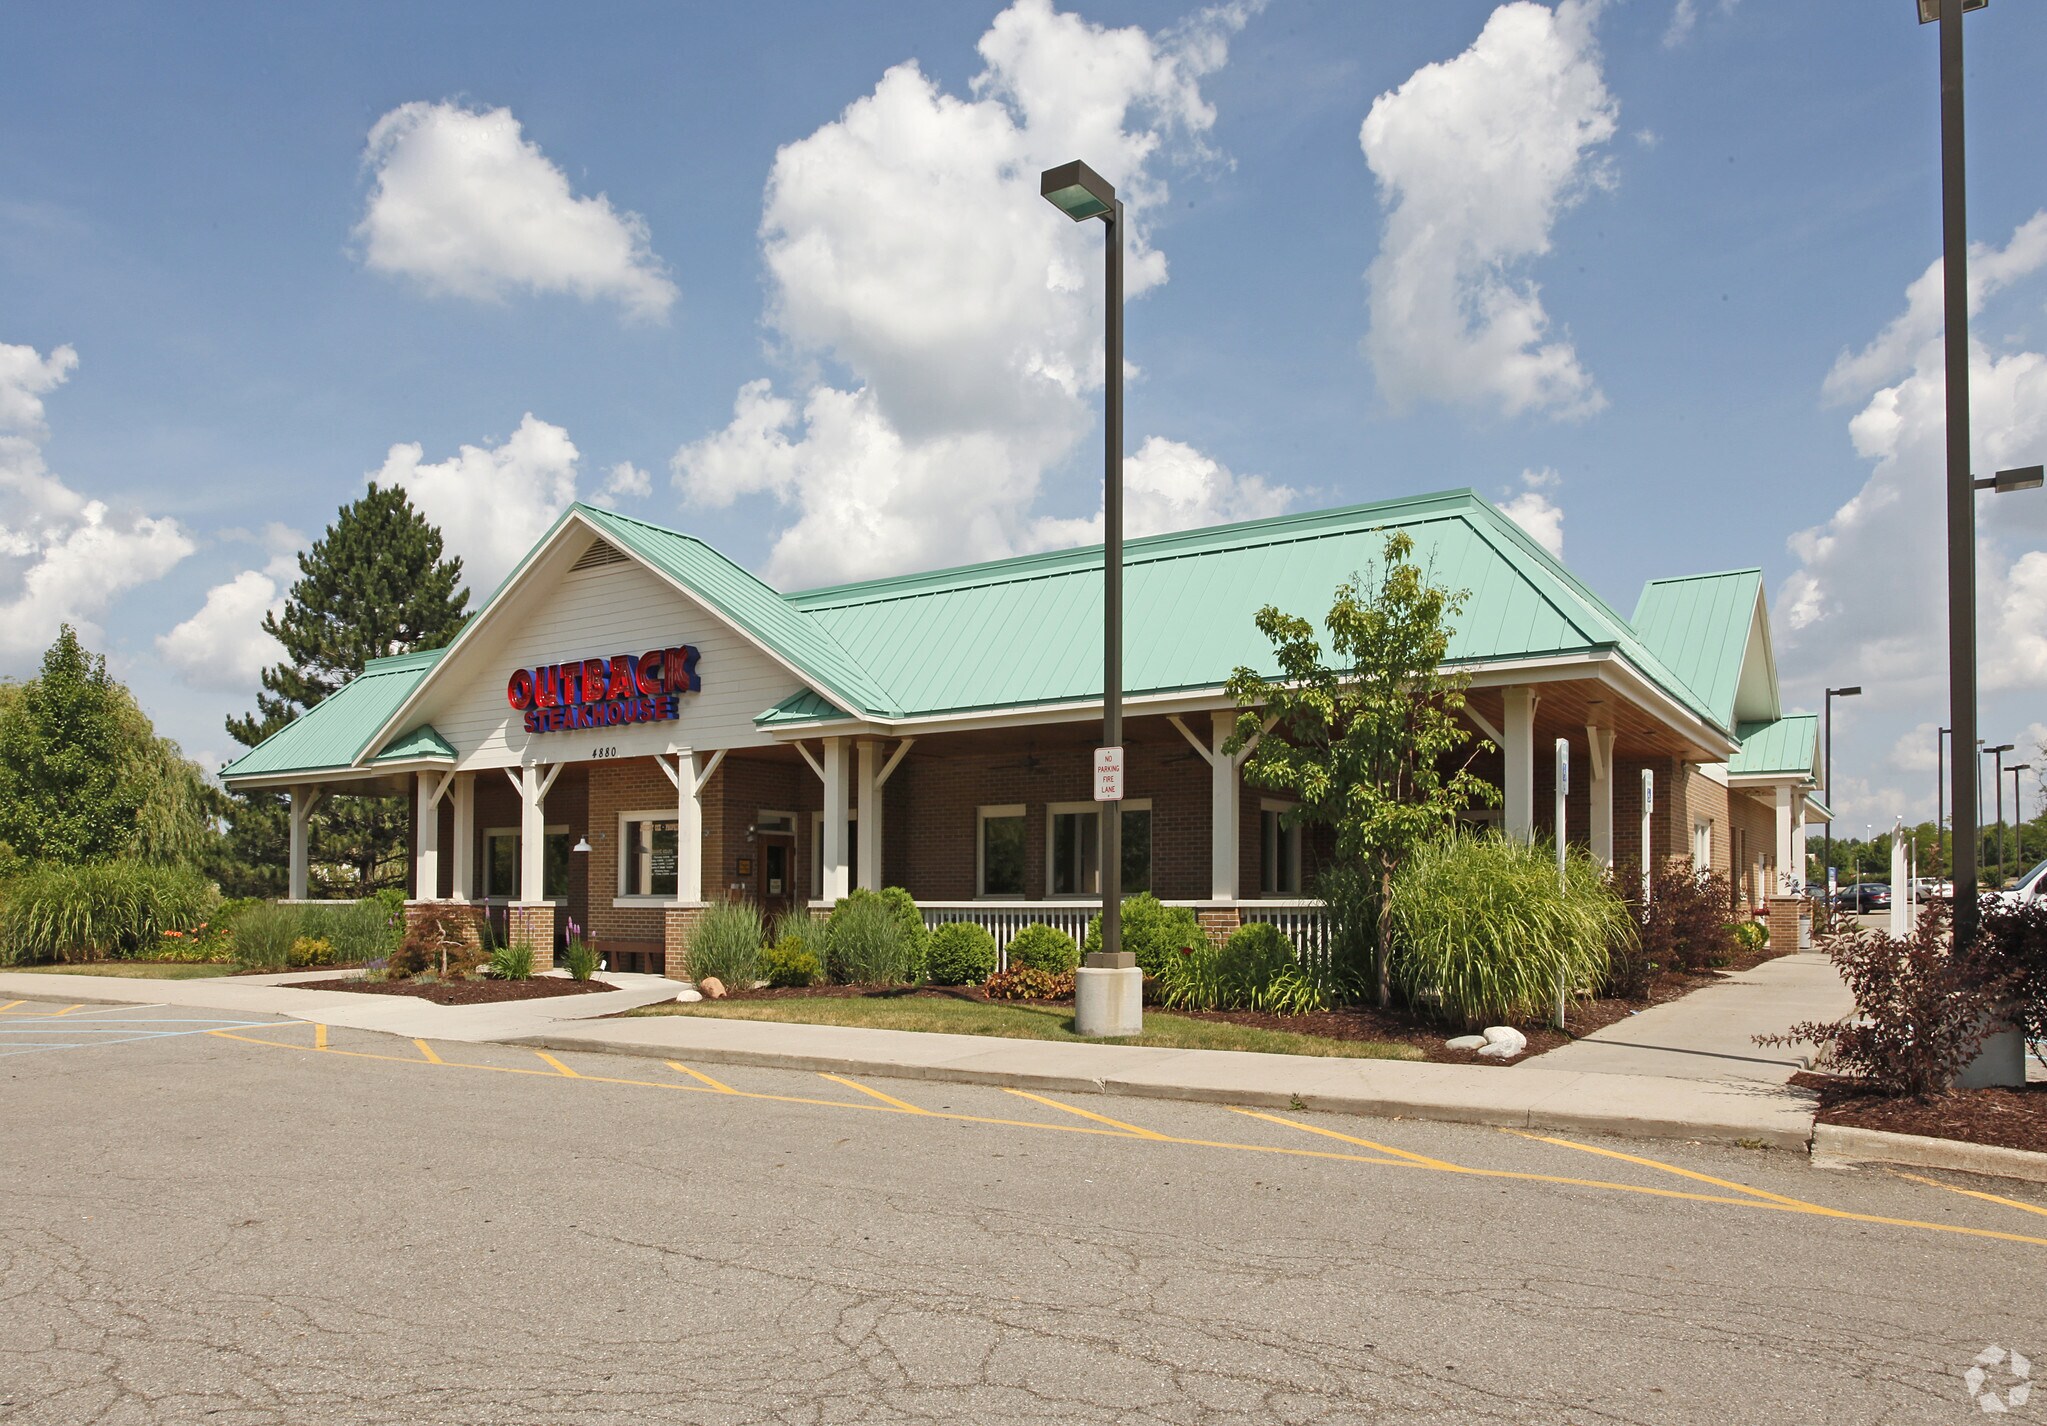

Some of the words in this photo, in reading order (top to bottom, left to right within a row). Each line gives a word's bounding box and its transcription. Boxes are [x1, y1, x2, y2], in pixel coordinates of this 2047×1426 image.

[508, 645, 700, 711] OUTBACK
[524, 696, 678, 733] STEAKHOUSE
[592, 746, 617, 759] 4880
[1104, 755, 1113, 763] NO
[1097, 765, 1120, 773] PARKING
[1102, 775, 1115, 783] FIRE
[1101, 785, 1116, 794] LANE
